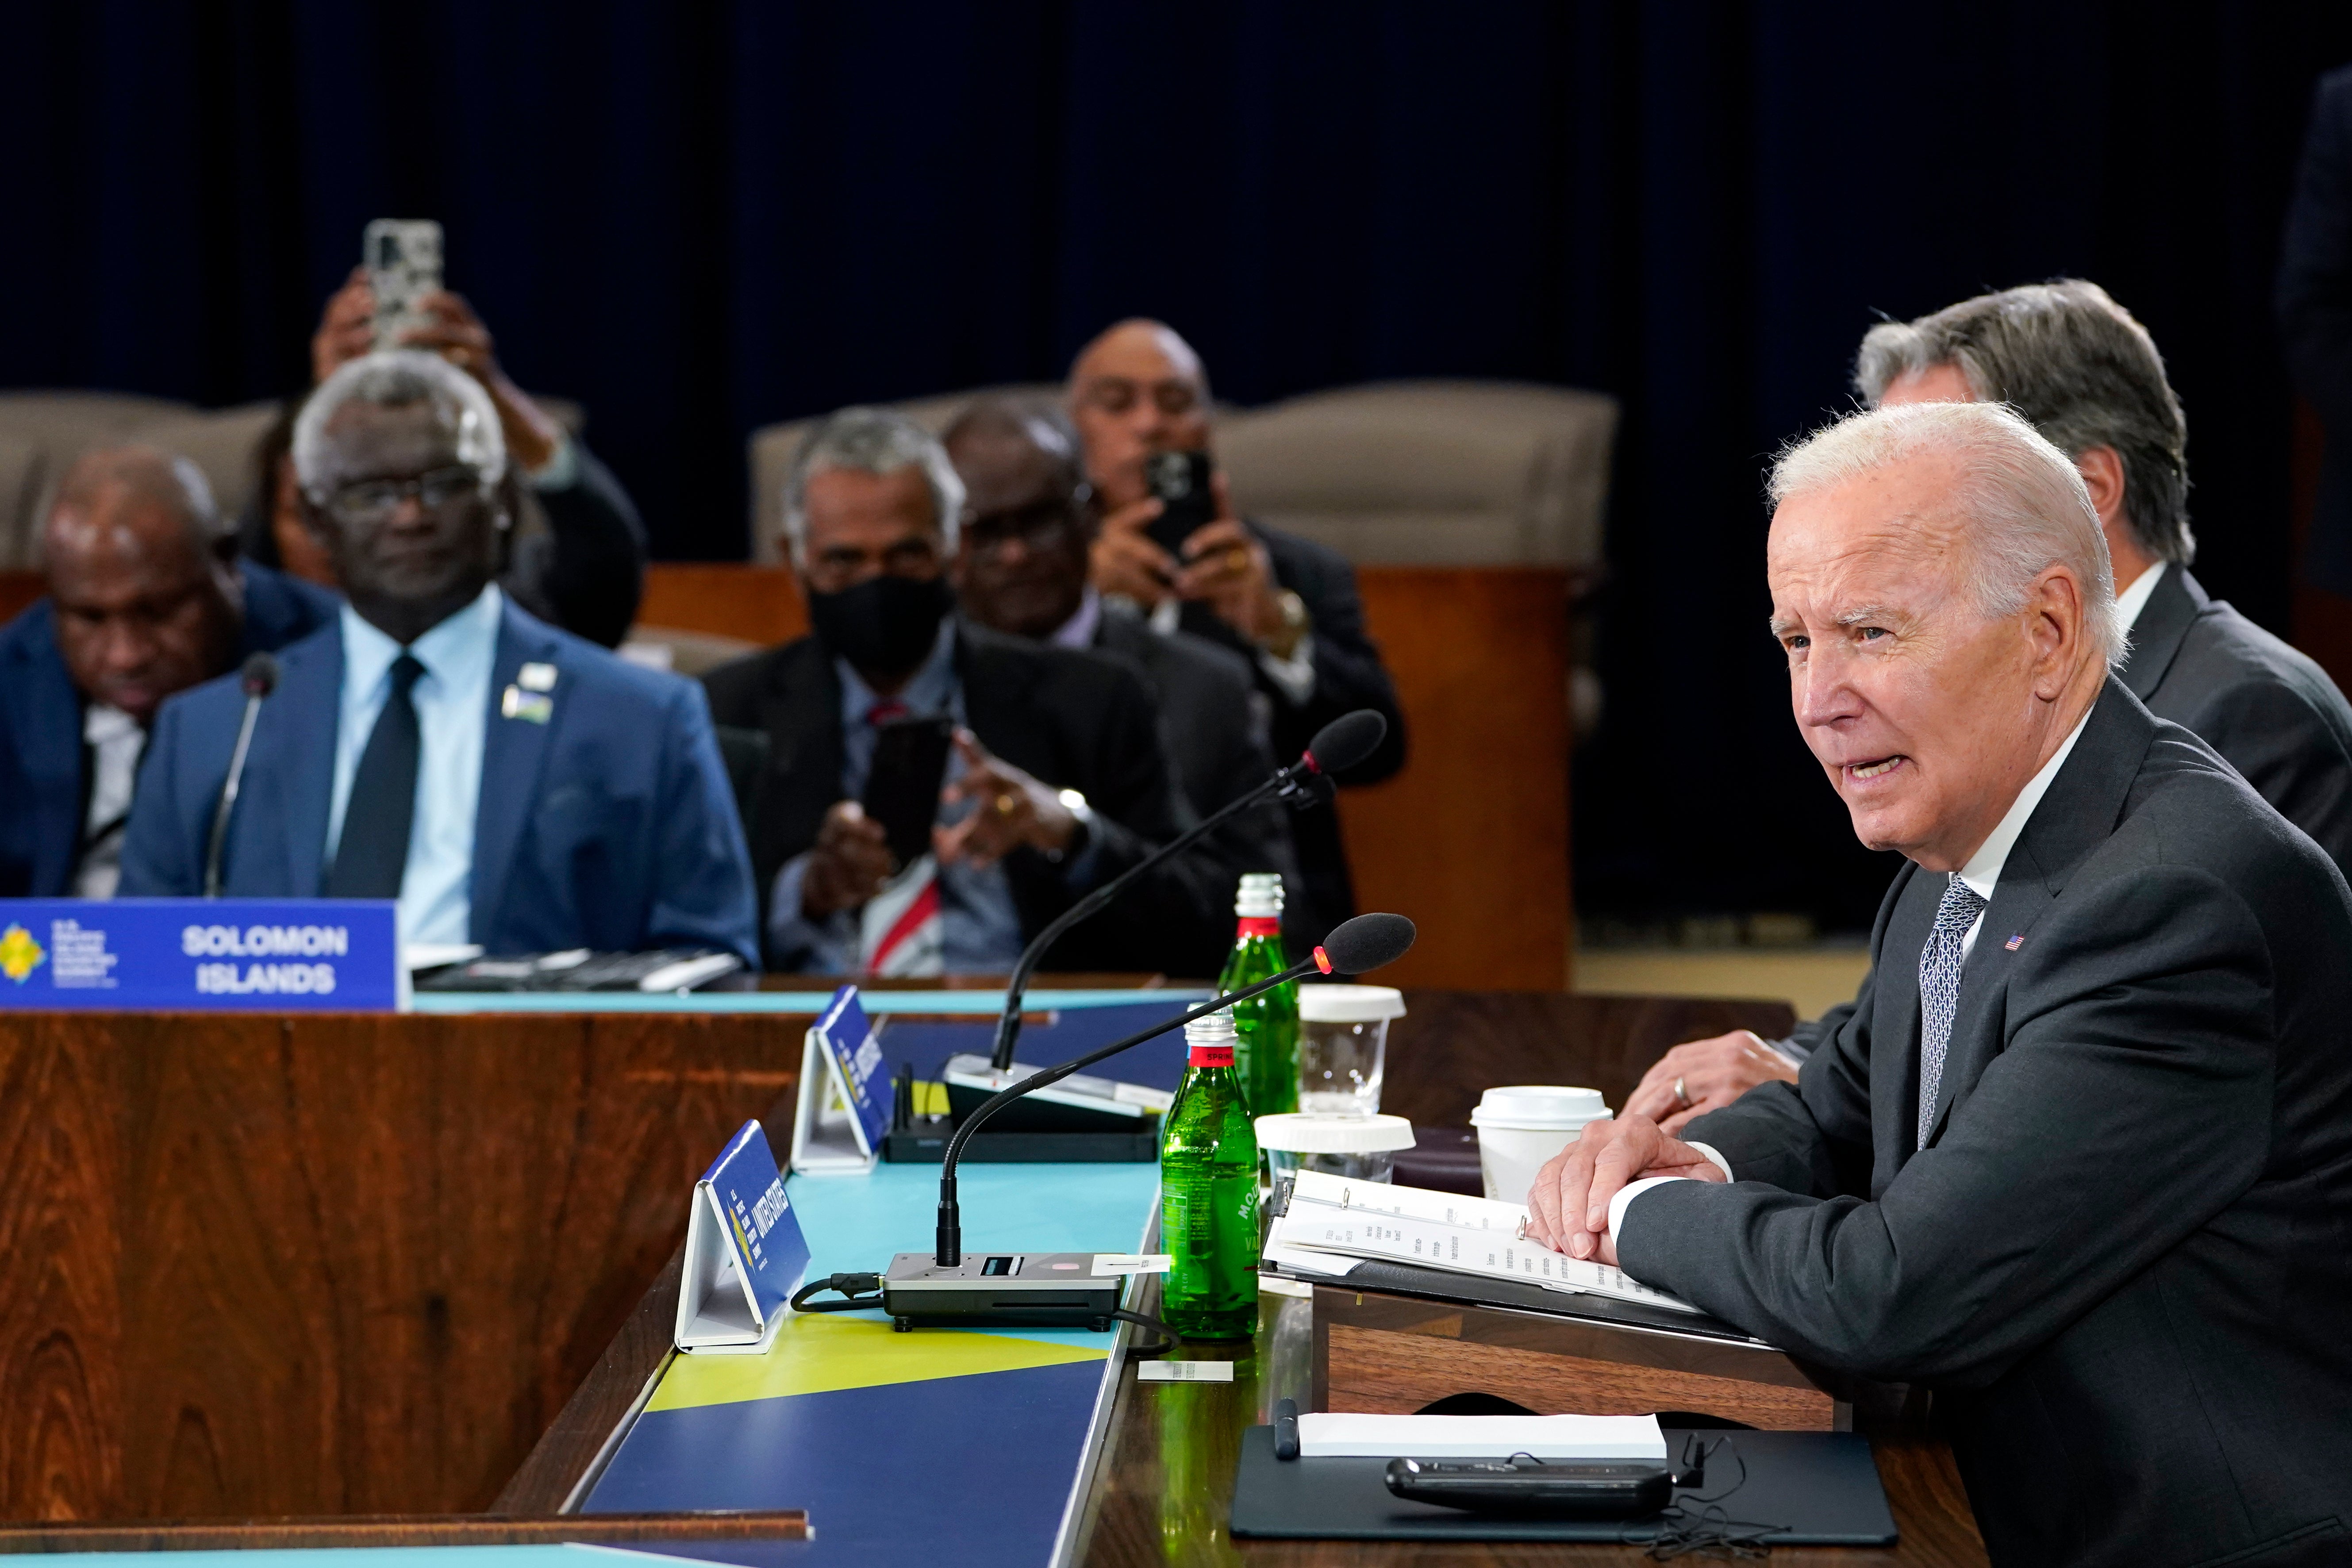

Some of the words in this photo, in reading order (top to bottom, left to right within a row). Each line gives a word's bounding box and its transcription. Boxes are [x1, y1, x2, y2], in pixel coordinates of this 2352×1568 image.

[182, 926, 348, 956] SOLOMON
[196, 964, 336, 994] ISLANDS
[751, 1195, 774, 1238] UNITED
[765, 1177, 788, 1221] STATES
